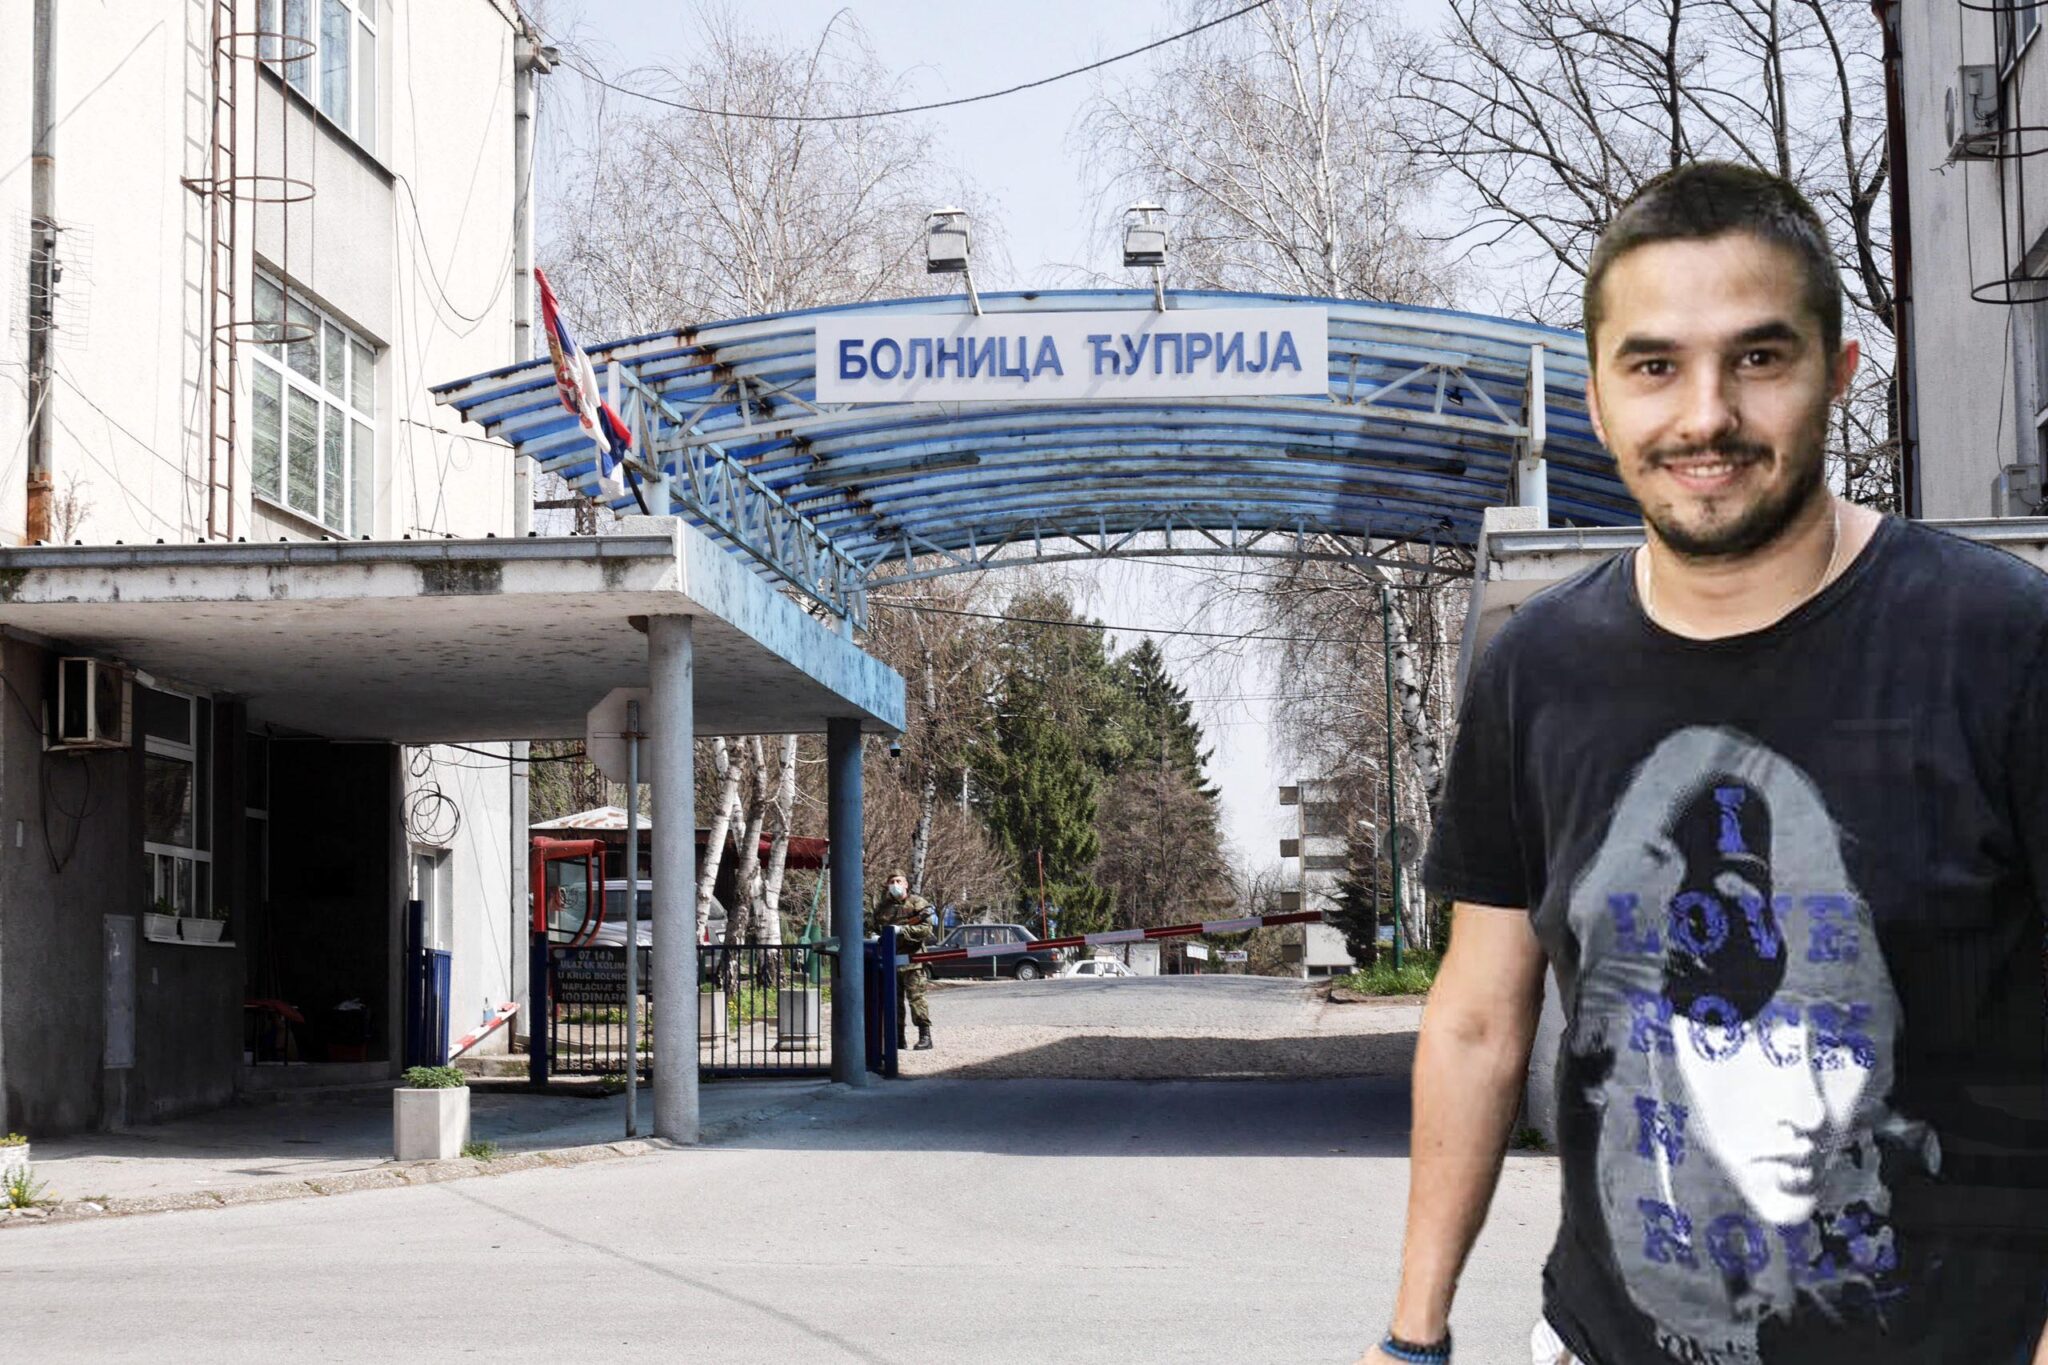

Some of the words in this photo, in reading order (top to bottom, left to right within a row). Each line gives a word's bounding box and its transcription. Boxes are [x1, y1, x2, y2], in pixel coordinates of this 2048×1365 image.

[839, 335, 1064, 383] БОЛНИЦА
[1087, 330, 1303, 377] ЋУПРИЈА
[1714, 787, 1748, 854] I
[1607, 889, 1858, 961] LOVE
[1624, 989, 1876, 1071] ROCK
[1634, 1095, 1688, 1166] N
